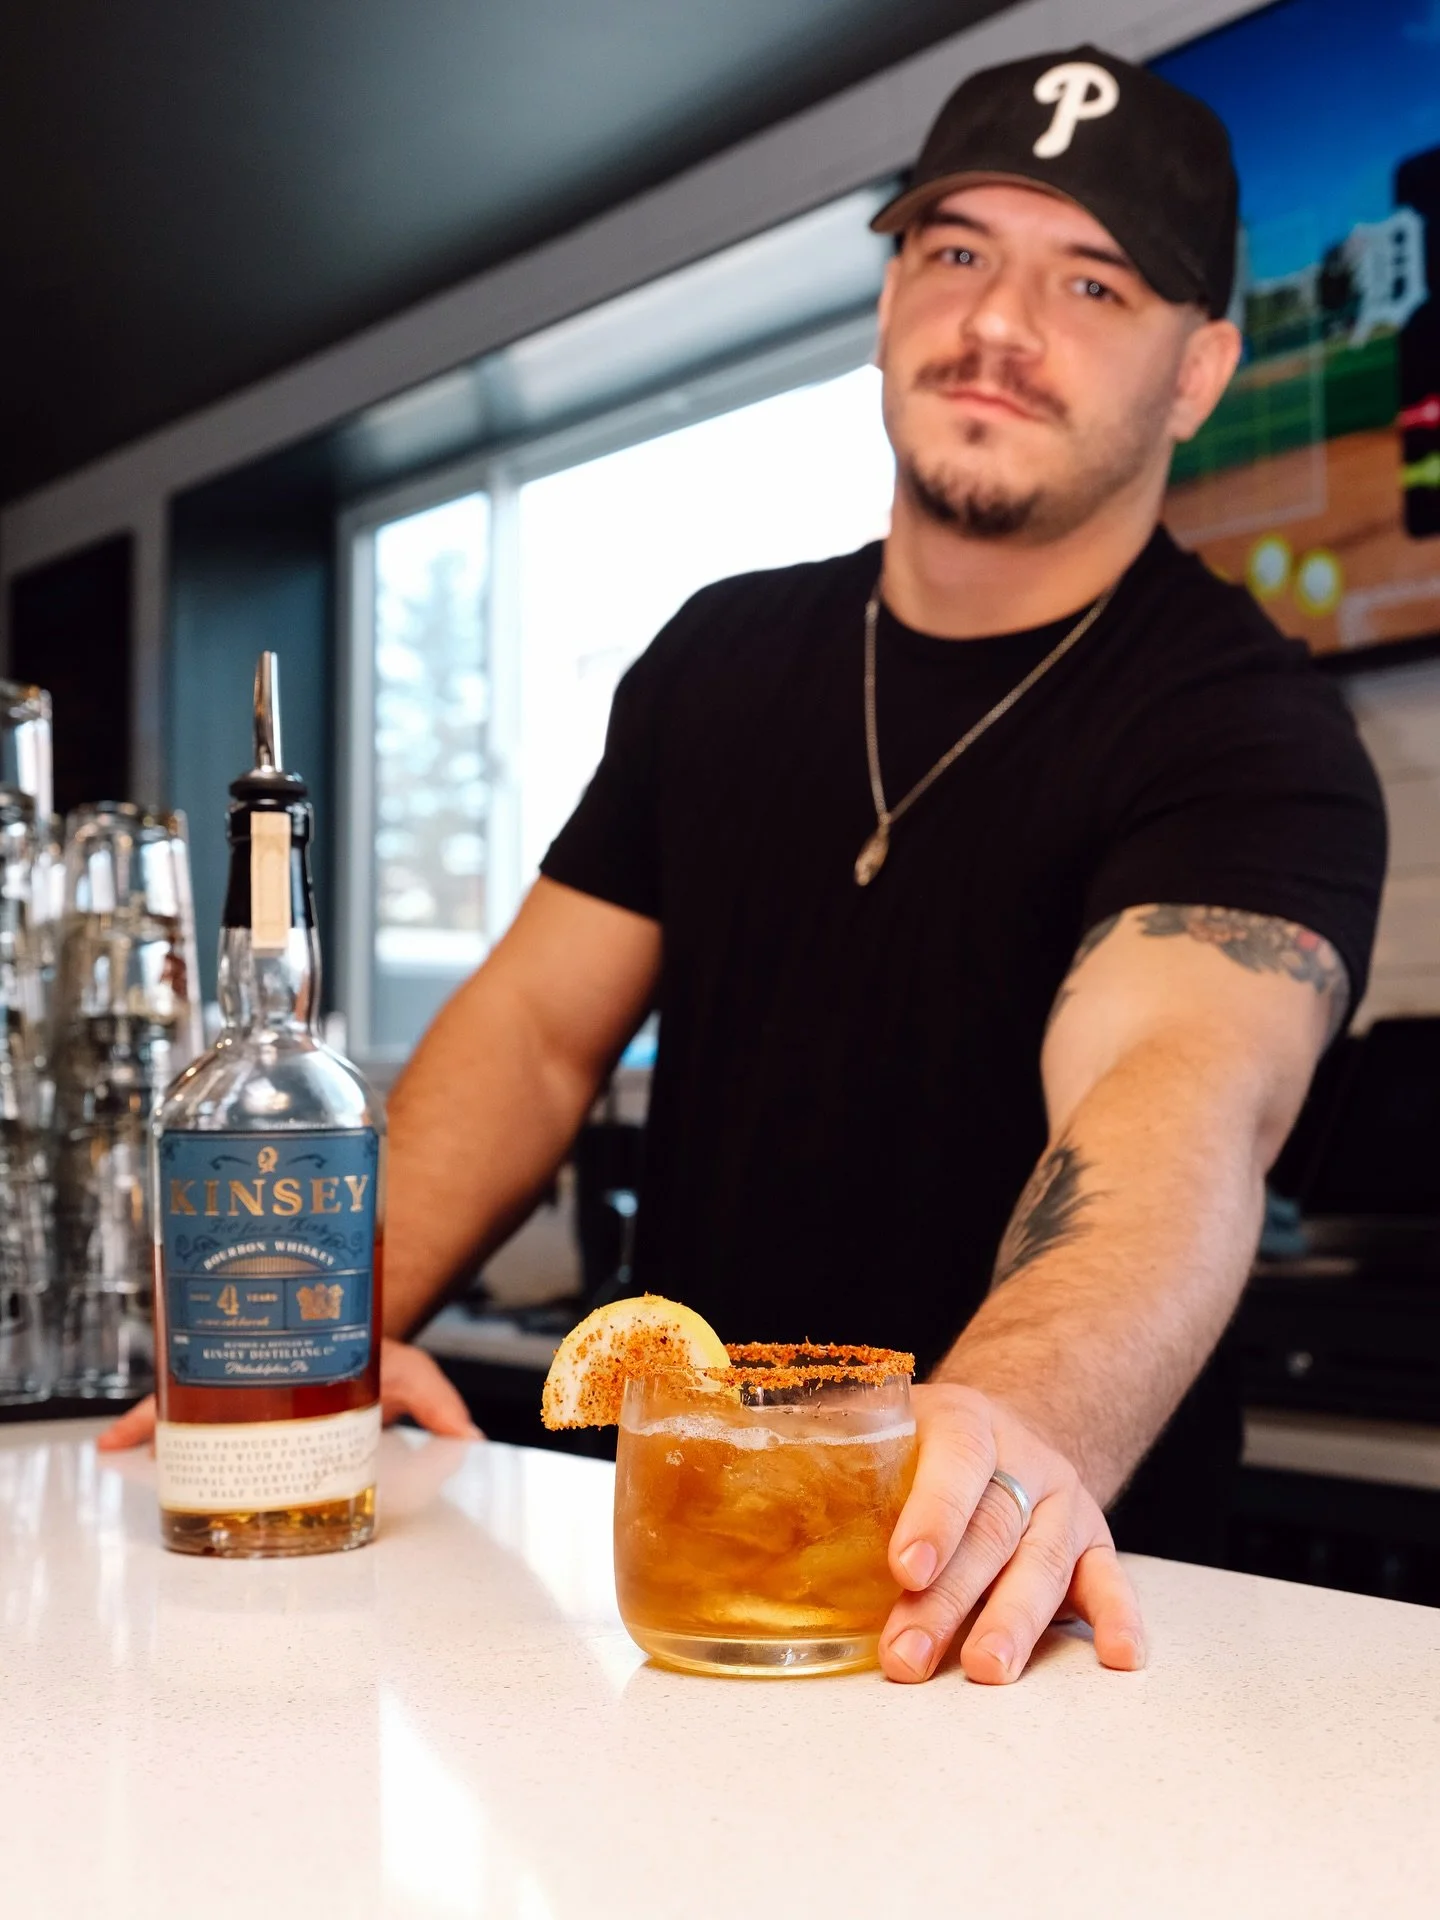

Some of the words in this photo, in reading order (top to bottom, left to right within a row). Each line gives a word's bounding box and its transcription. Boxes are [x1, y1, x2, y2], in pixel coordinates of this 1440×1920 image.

[1033, 62, 1119, 158] P
[169, 1174, 369, 1216] KINSEY
[204, 1240, 266, 1270] BOURBON
[274, 1240, 334, 1266] WHISKEY
[216, 1284, 239, 1316] 4
[246, 1293, 278, 1303] YEARS
[202, 1348, 244, 1360] KINSEY
[249, 1347, 322, 1360] DISTILLING
[214, 1437, 289, 1450] PRODUCED
[236, 1449, 272, 1461] WITH
[280, 1442, 342, 1459] FORMULA
[209, 1460, 294, 1474] DEVELOPED
[210, 1488, 245, 1499] HALF
[253, 1483, 319, 1498] CENTURY
